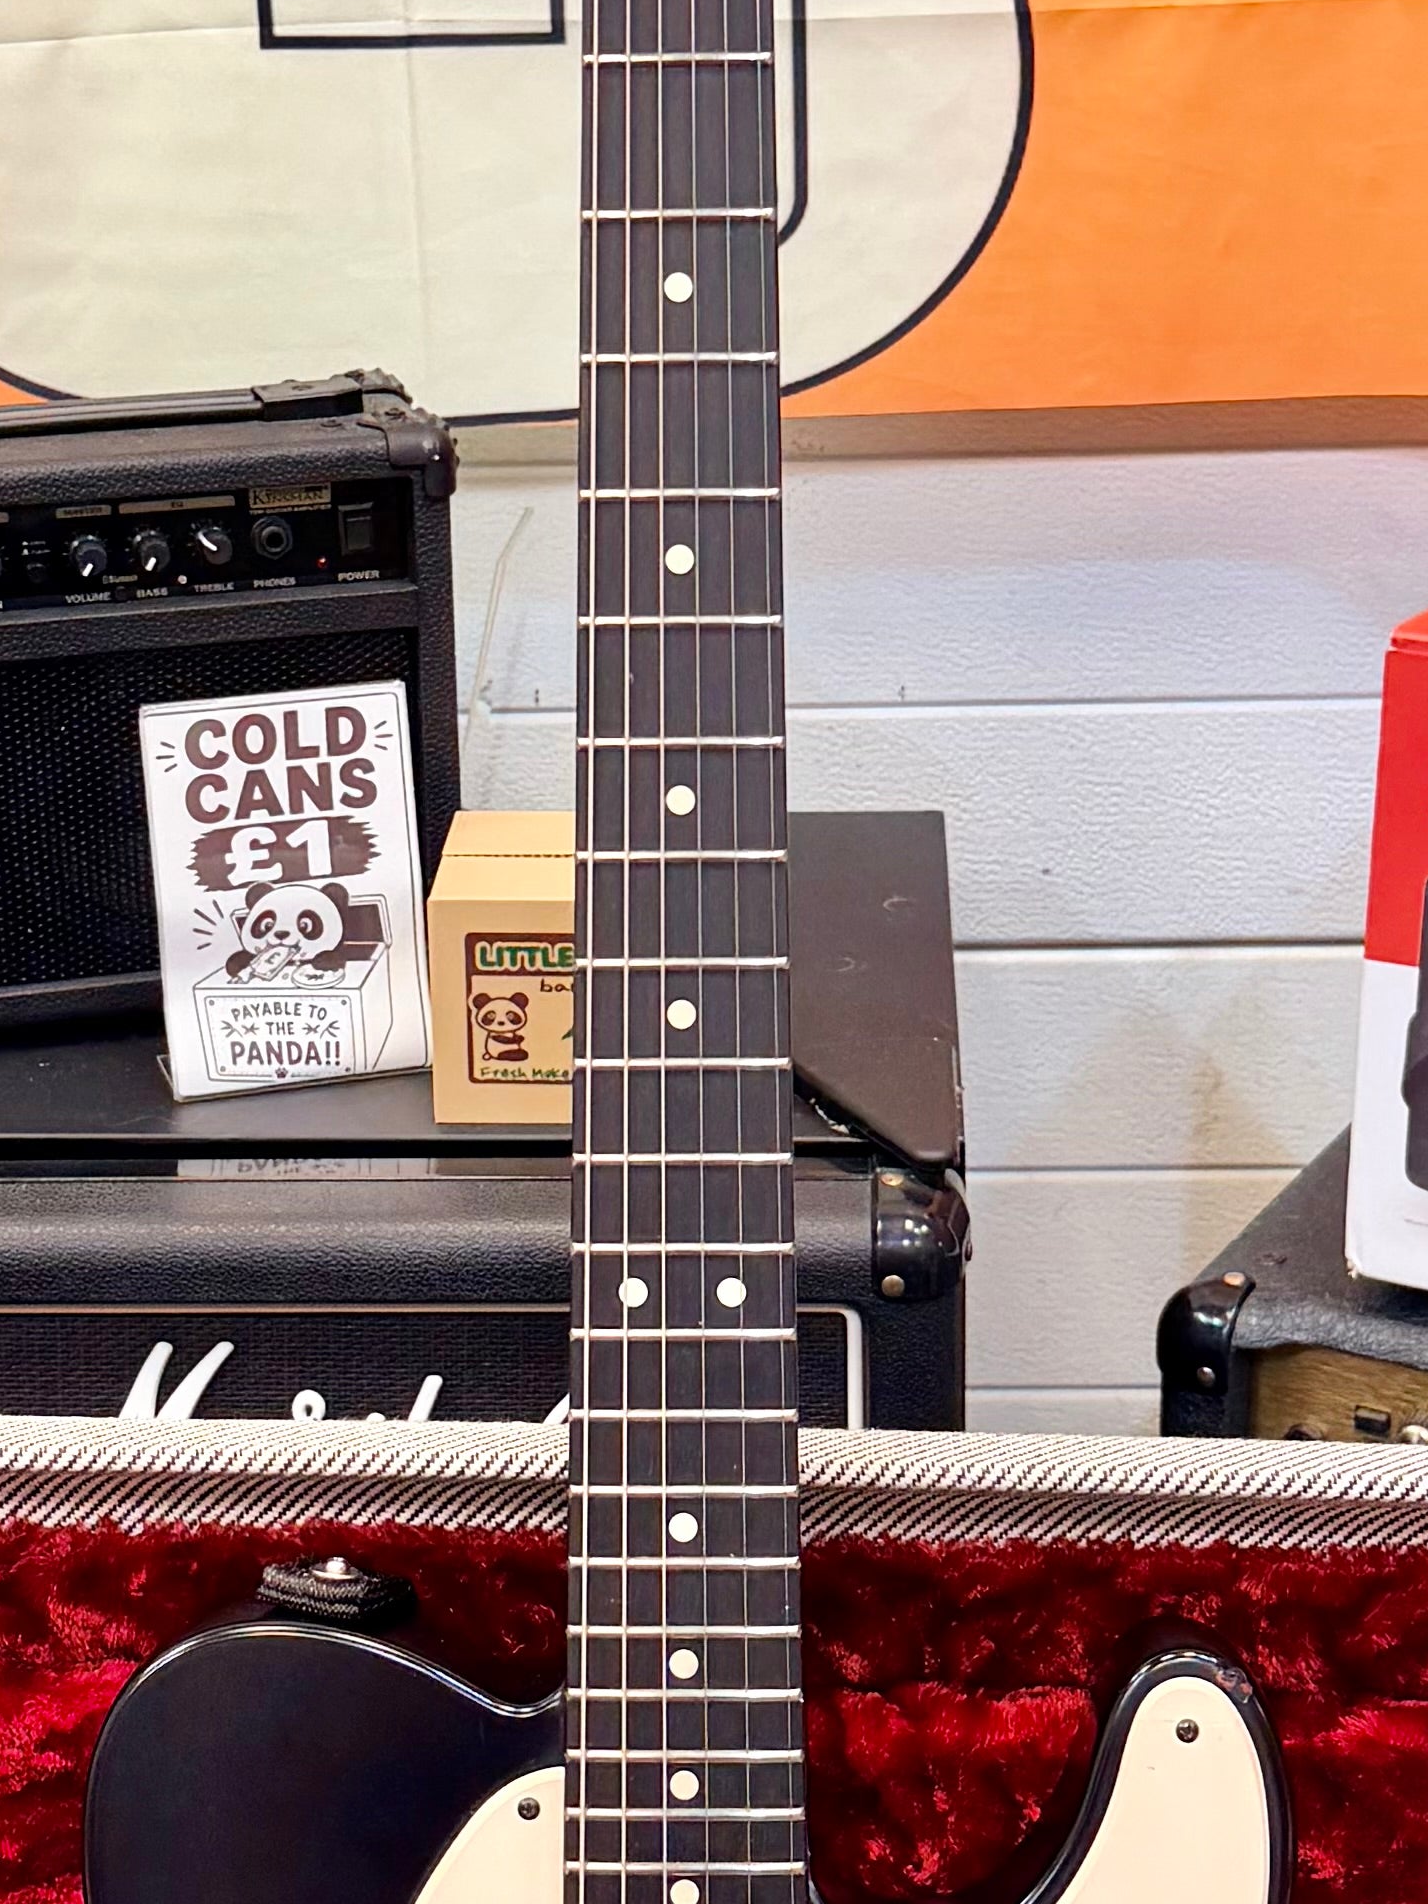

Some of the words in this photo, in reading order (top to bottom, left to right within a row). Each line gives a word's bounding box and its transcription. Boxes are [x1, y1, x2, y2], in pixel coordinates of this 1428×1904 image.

[253, 576, 296, 588] PHONES
[337, 569, 380, 582] POWER
[136, 587, 168, 598] BASS
[194, 581, 235, 593] TREBLE
[65, 591, 112, 604] VOLUME
[184, 705, 367, 770] COLD
[184, 757, 378, 824] CANS
[224, 818, 333, 887] £1
[477, 944, 574, 970] LITTLE
[539, 977, 574, 993] ba
[230, 1001, 303, 1022] PAYABLE
[308, 1004, 328, 1021] TO
[264, 1021, 295, 1036] THE
[230, 1040, 341, 1066] PANDA!!
